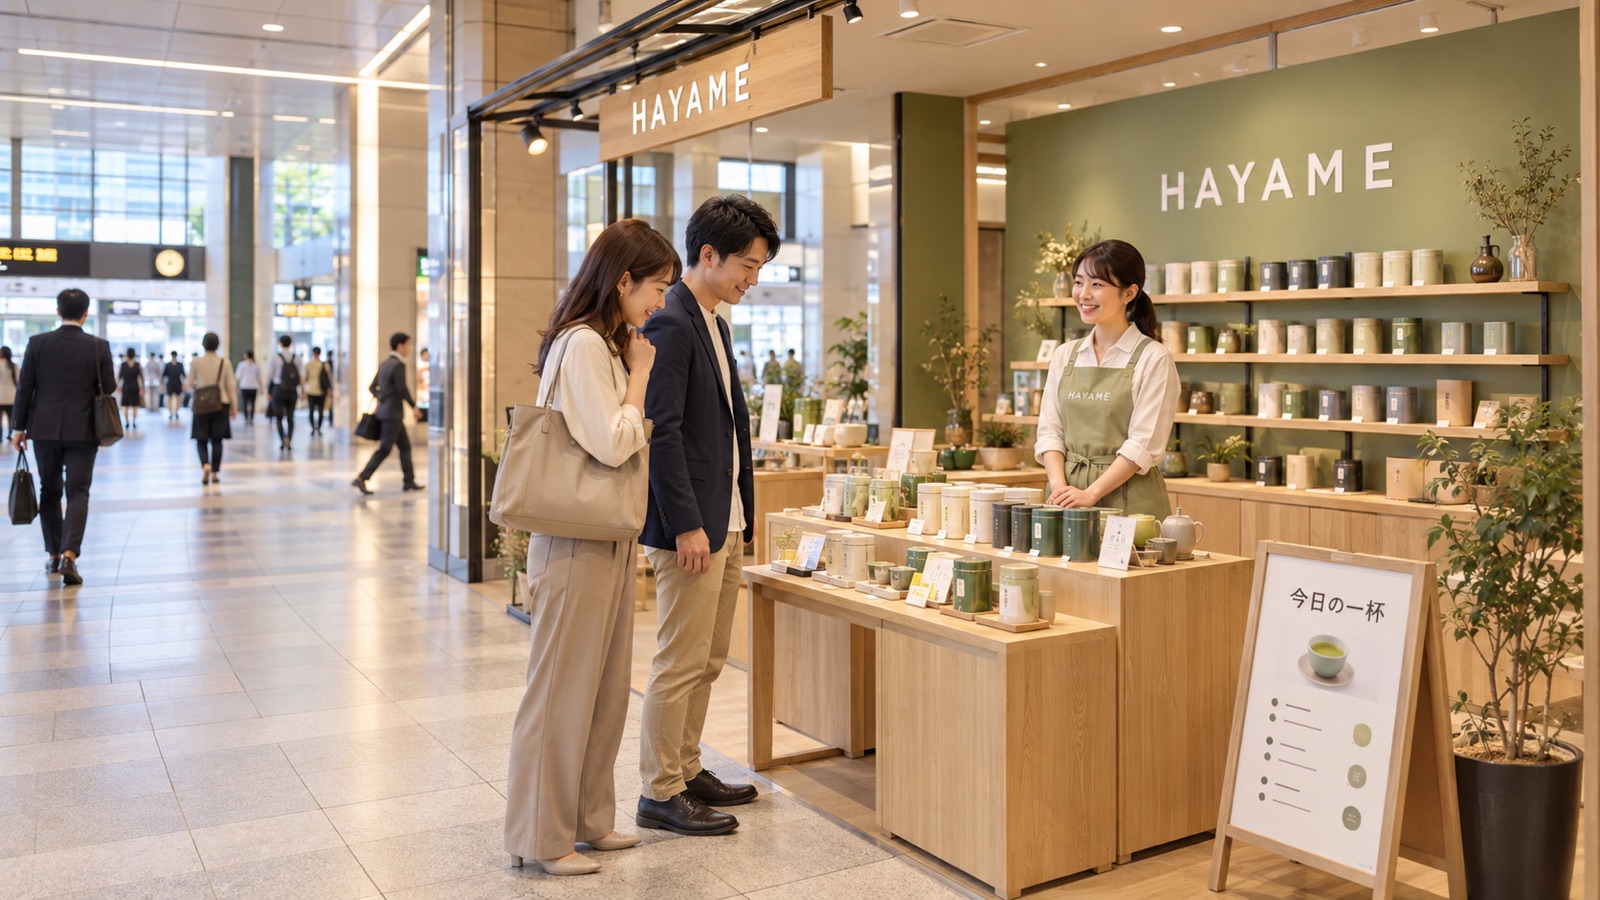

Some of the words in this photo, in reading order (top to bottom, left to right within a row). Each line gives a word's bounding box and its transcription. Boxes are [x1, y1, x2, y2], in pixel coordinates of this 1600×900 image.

[632, 62, 750, 135] HAYAME
[1161, 142, 1394, 212] HAYAME
[1068, 391, 1111, 402] HAYAME
[1290, 587, 1386, 623] 今日の一杯
